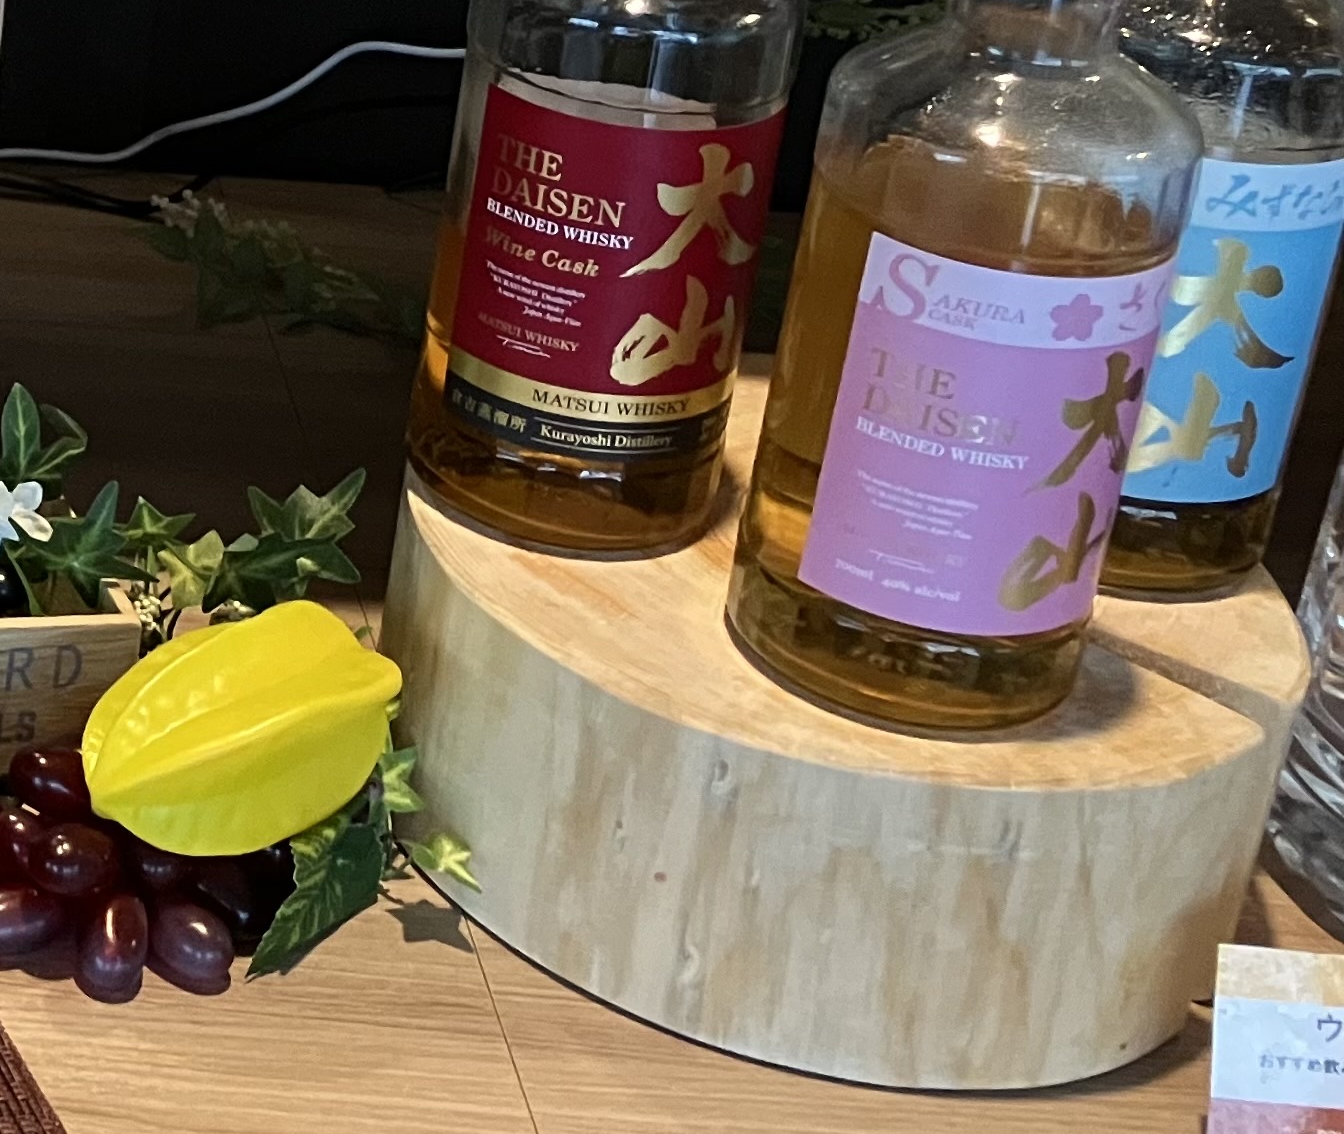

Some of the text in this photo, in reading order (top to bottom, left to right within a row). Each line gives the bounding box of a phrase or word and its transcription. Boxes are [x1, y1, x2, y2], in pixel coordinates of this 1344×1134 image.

[496, 132, 564, 182] THE
[490, 165, 627, 229] DAISEN
[486, 196, 635, 251] BLENDED WHISKY
[484, 223, 600, 277] Wine Cask
[609, 142, 757, 387] 大山
[868, 252, 1027, 325] SAKURA
[477, 311, 523, 338] MATSUI
[524, 328, 580, 352] WHISKY
[927, 308, 977, 332] CASK
[531, 388, 691, 416] MATSUI WHISKY
[539, 423, 674, 449] Kurayoshi Distillery
[854, 415, 1030, 471] BLENDED WHISKY
[1316, 1013, 1344, 1043] ウ
